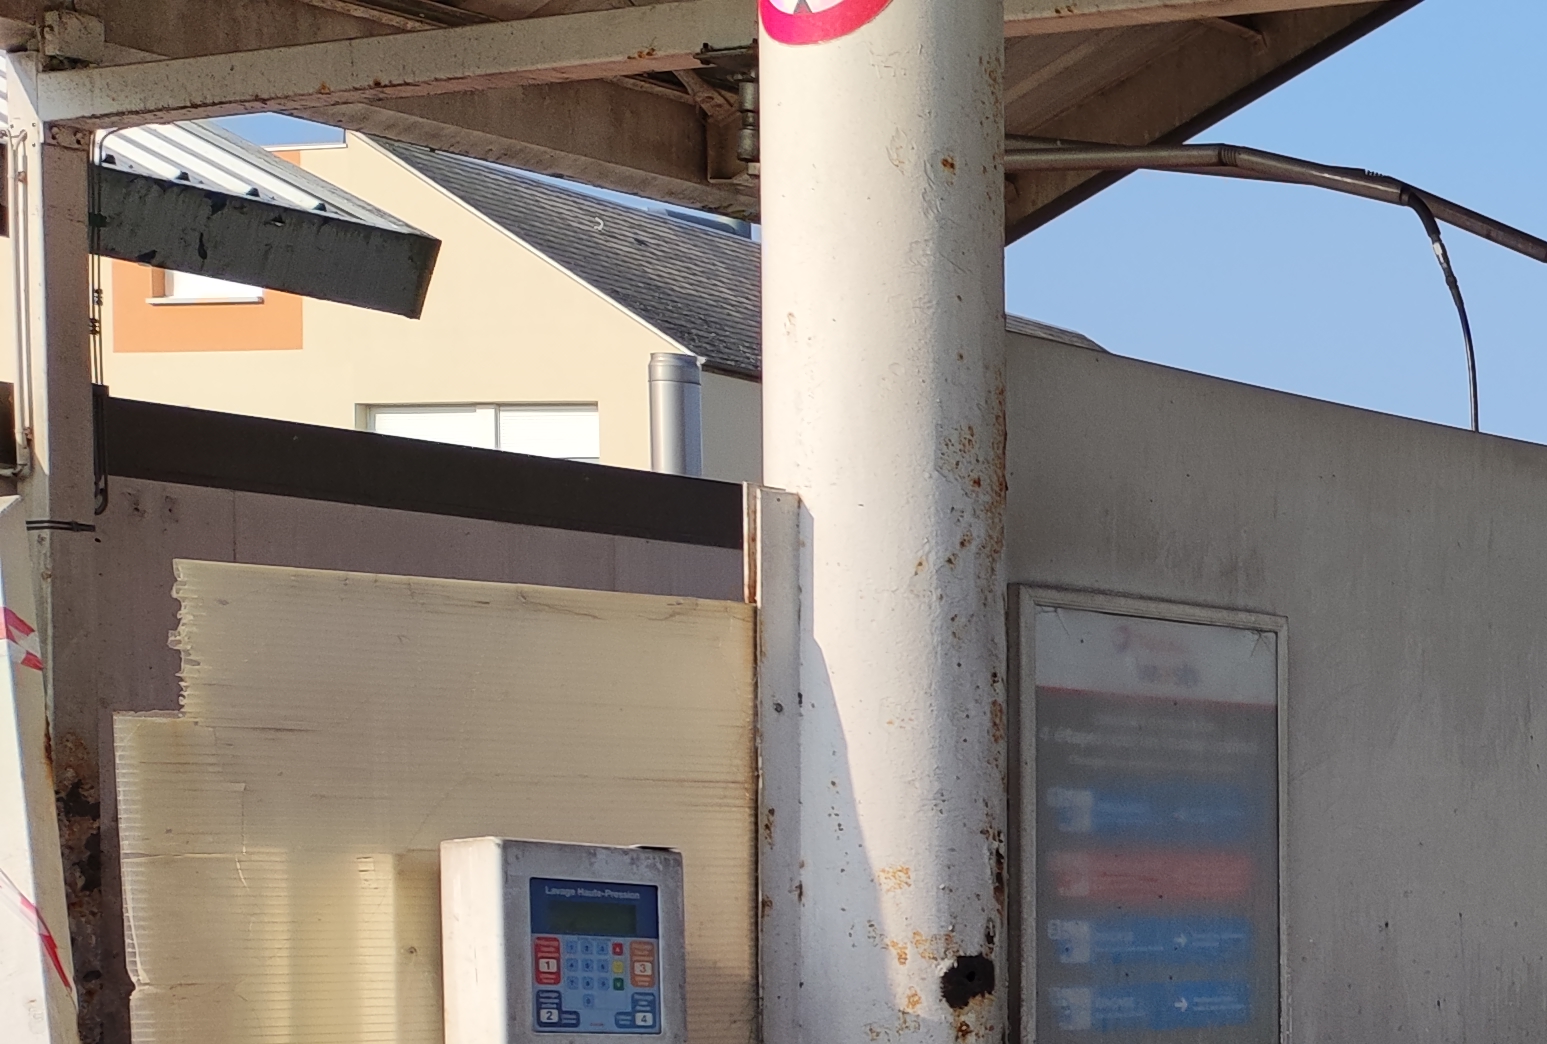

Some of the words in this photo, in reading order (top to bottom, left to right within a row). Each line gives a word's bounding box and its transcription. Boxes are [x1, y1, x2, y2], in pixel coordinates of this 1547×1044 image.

[545, 885, 576, 897] Lavage
[577, 888, 640, 899] Haute-Pression
[545, 961, 550, 970] 1
[640, 963, 647, 973] 3
[546, 1010, 553, 1021] 2
[641, 1015, 648, 1023] 4
